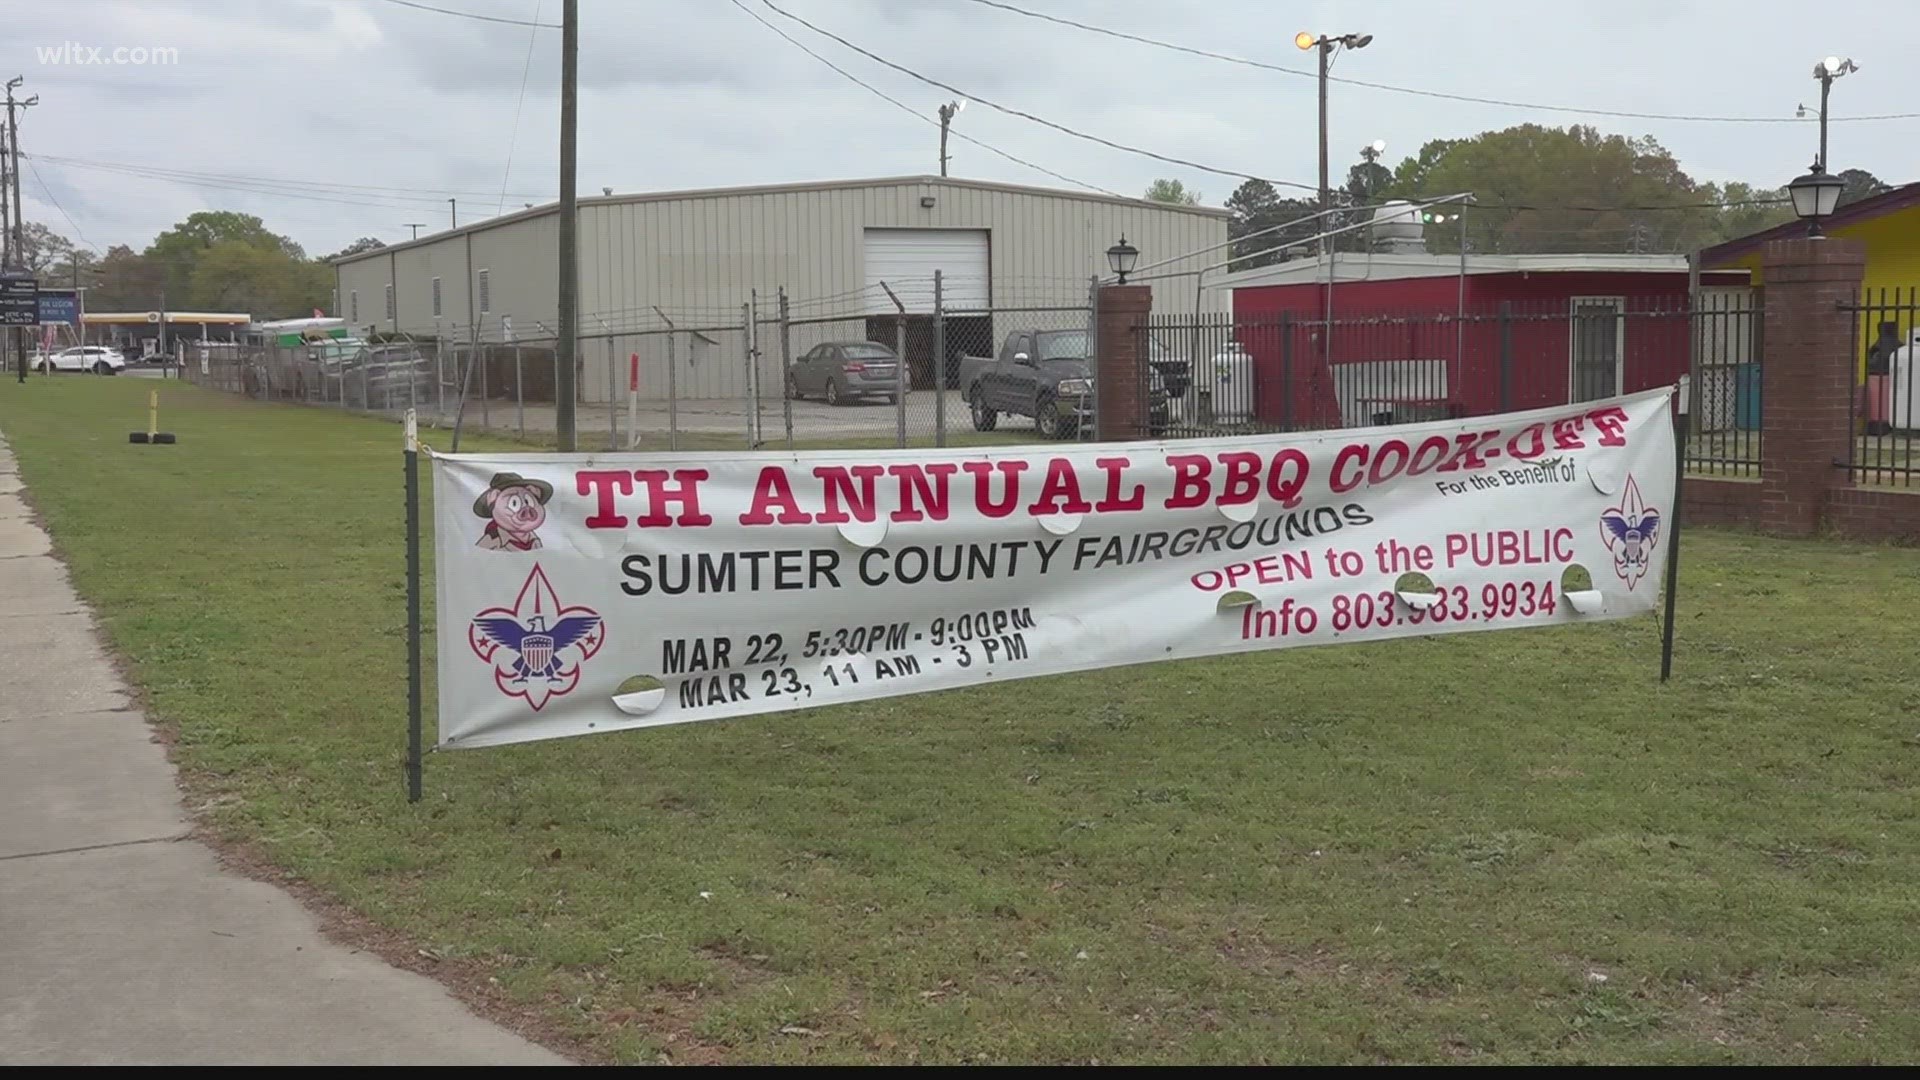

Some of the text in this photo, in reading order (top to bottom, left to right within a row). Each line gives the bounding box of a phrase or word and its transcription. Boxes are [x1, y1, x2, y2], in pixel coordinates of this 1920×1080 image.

[576, 407, 1629, 529] TH ANNUAL BBQ COOK-OFF
[1436, 457, 1576, 497] For the Benefit of
[620, 503, 1374, 596] SUMTER COUNTY FAIRGROUNDS
[1191, 527, 1575, 592] OPEN to the PUBLIC
[662, 638, 732, 675] MAR
[744, 633, 788, 666] 22,
[803, 621, 911, 659] 5:30PM
[931, 607, 1038, 646] 9:00PM
[1242, 598, 1318, 640] Info
[679, 672, 751, 710] MAR
[761, 667, 812, 699] 23,
[824, 661, 859, 688] 11
[875, 654, 922, 680] AM
[952, 645, 972, 669] 3
[980, 632, 1029, 664] PM
